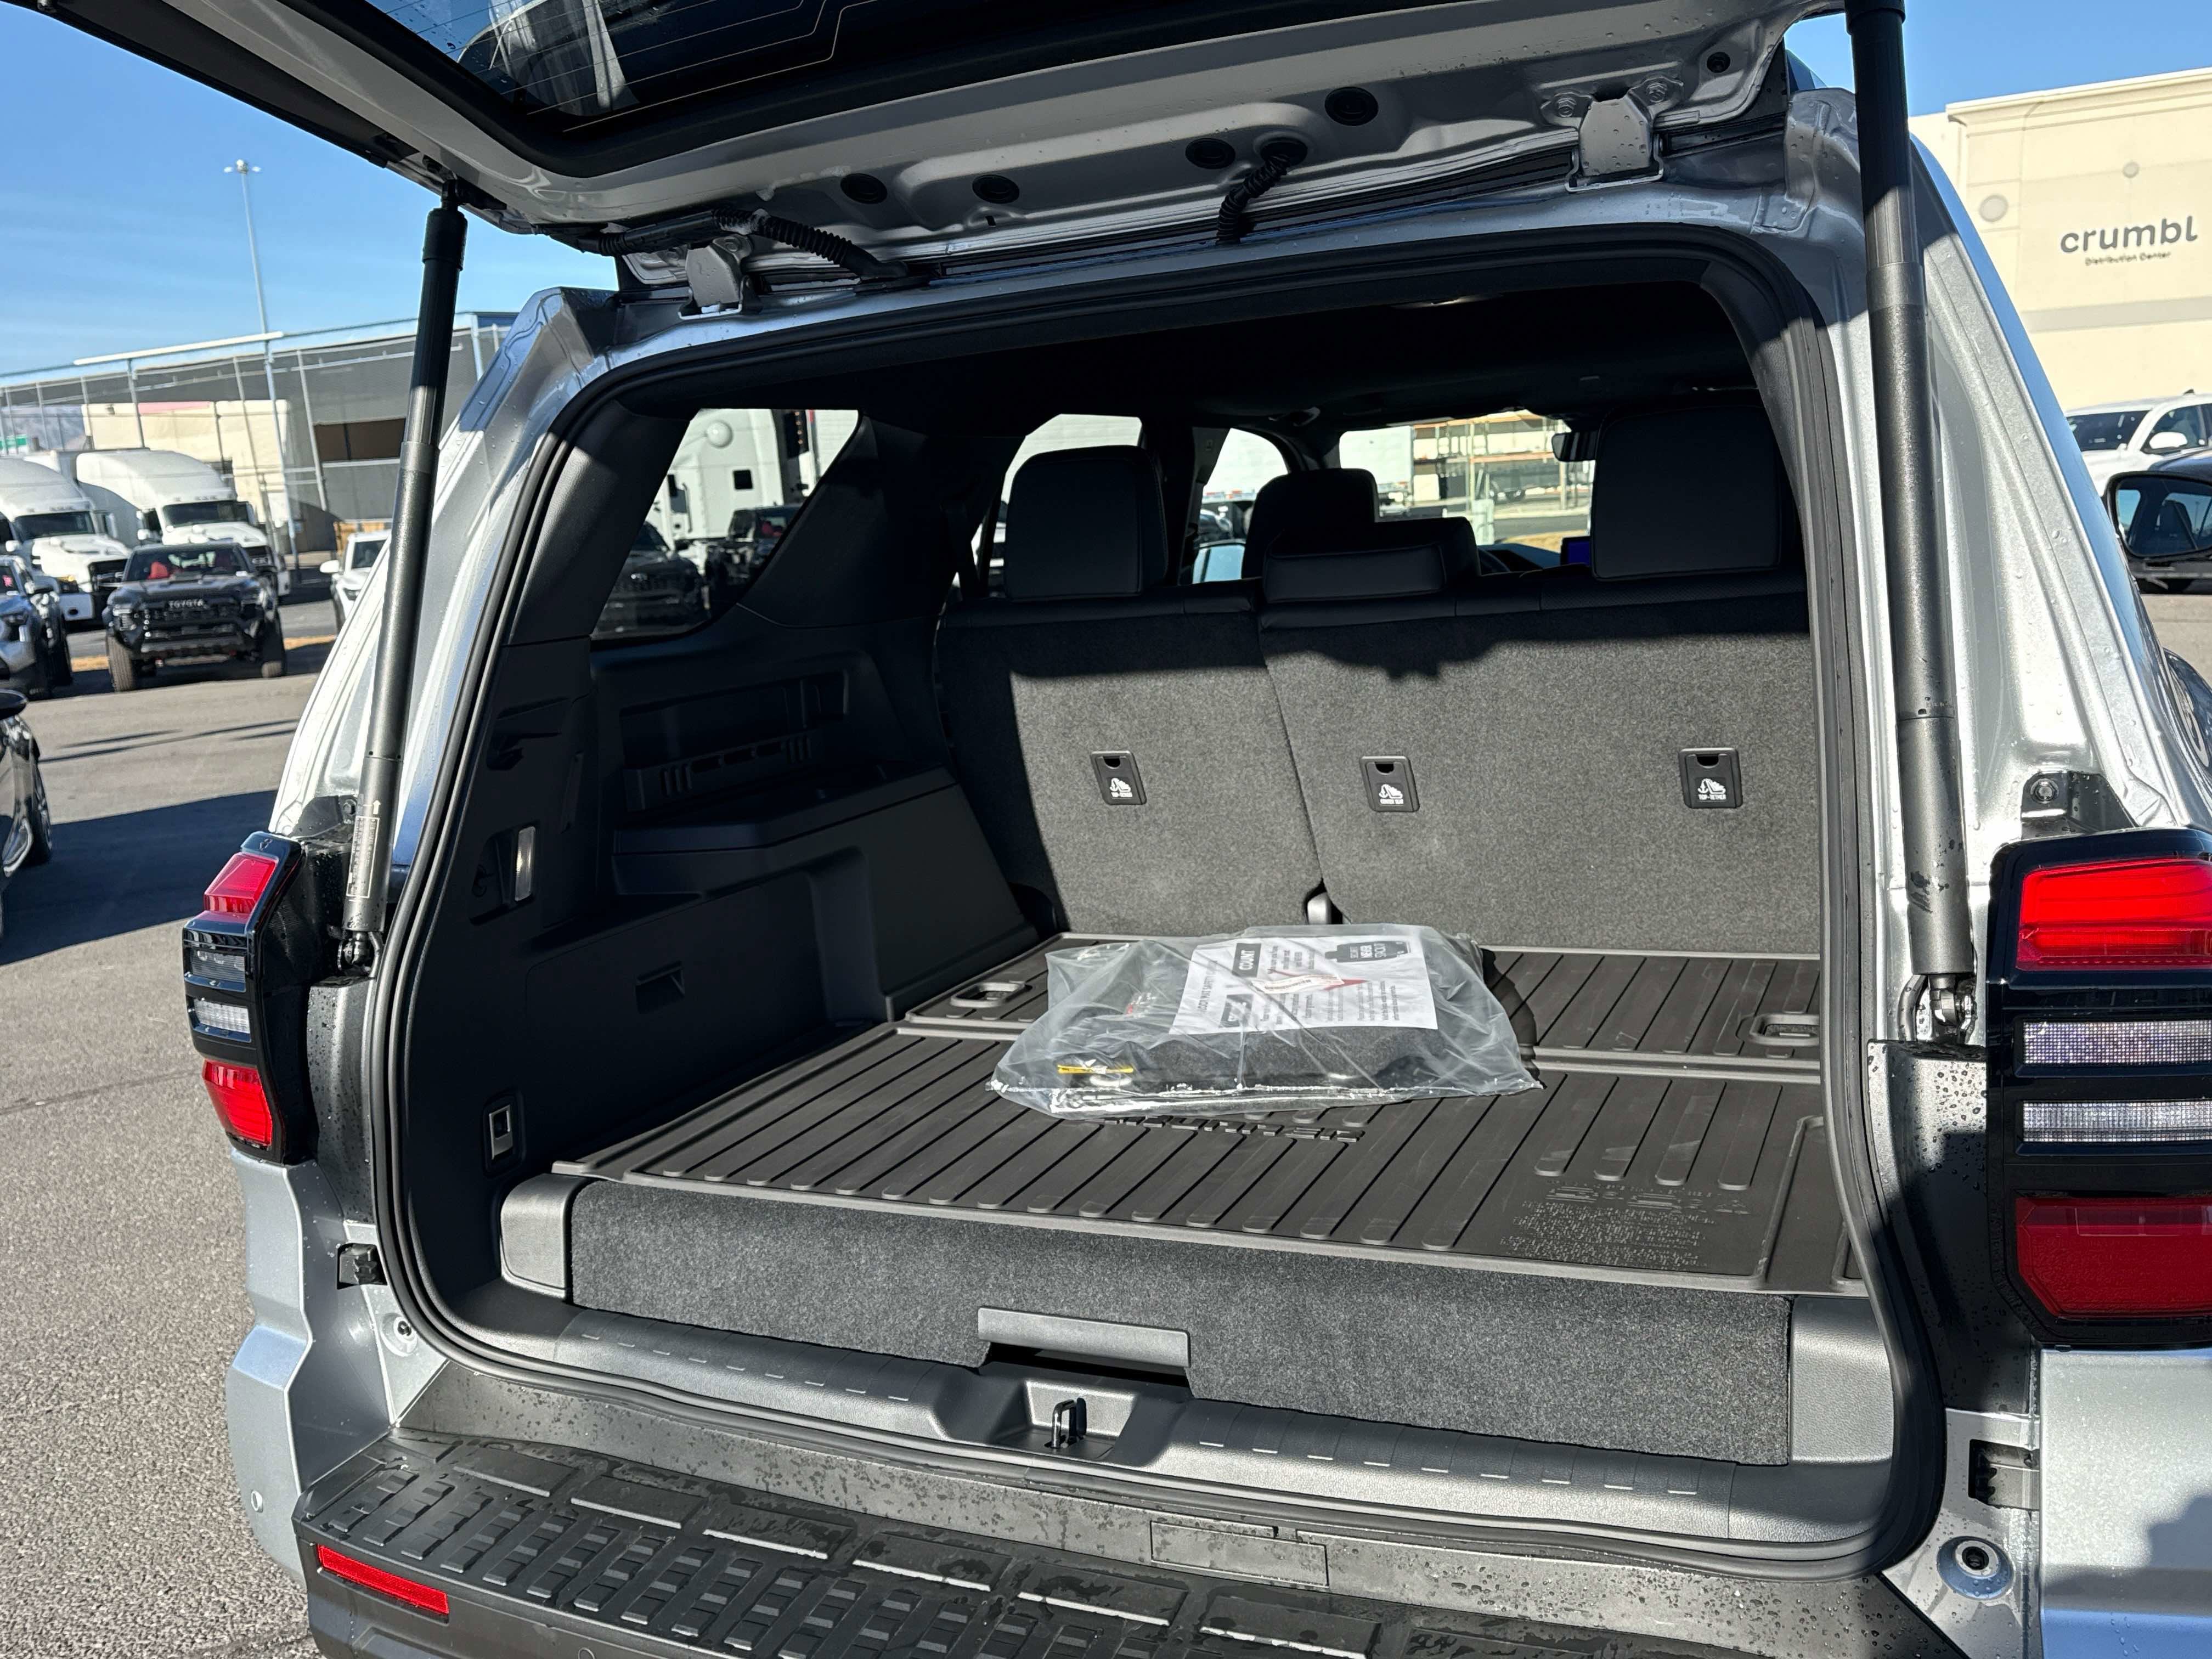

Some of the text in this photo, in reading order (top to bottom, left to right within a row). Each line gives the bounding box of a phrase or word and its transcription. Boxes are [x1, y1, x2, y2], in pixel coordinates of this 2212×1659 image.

[2061, 216, 2198, 253] crumbl
[2085, 251, 2171, 266] Distribution Center
[168, 599, 204, 608] TOYOTA
[1239, 950, 1255, 970] COUNT
